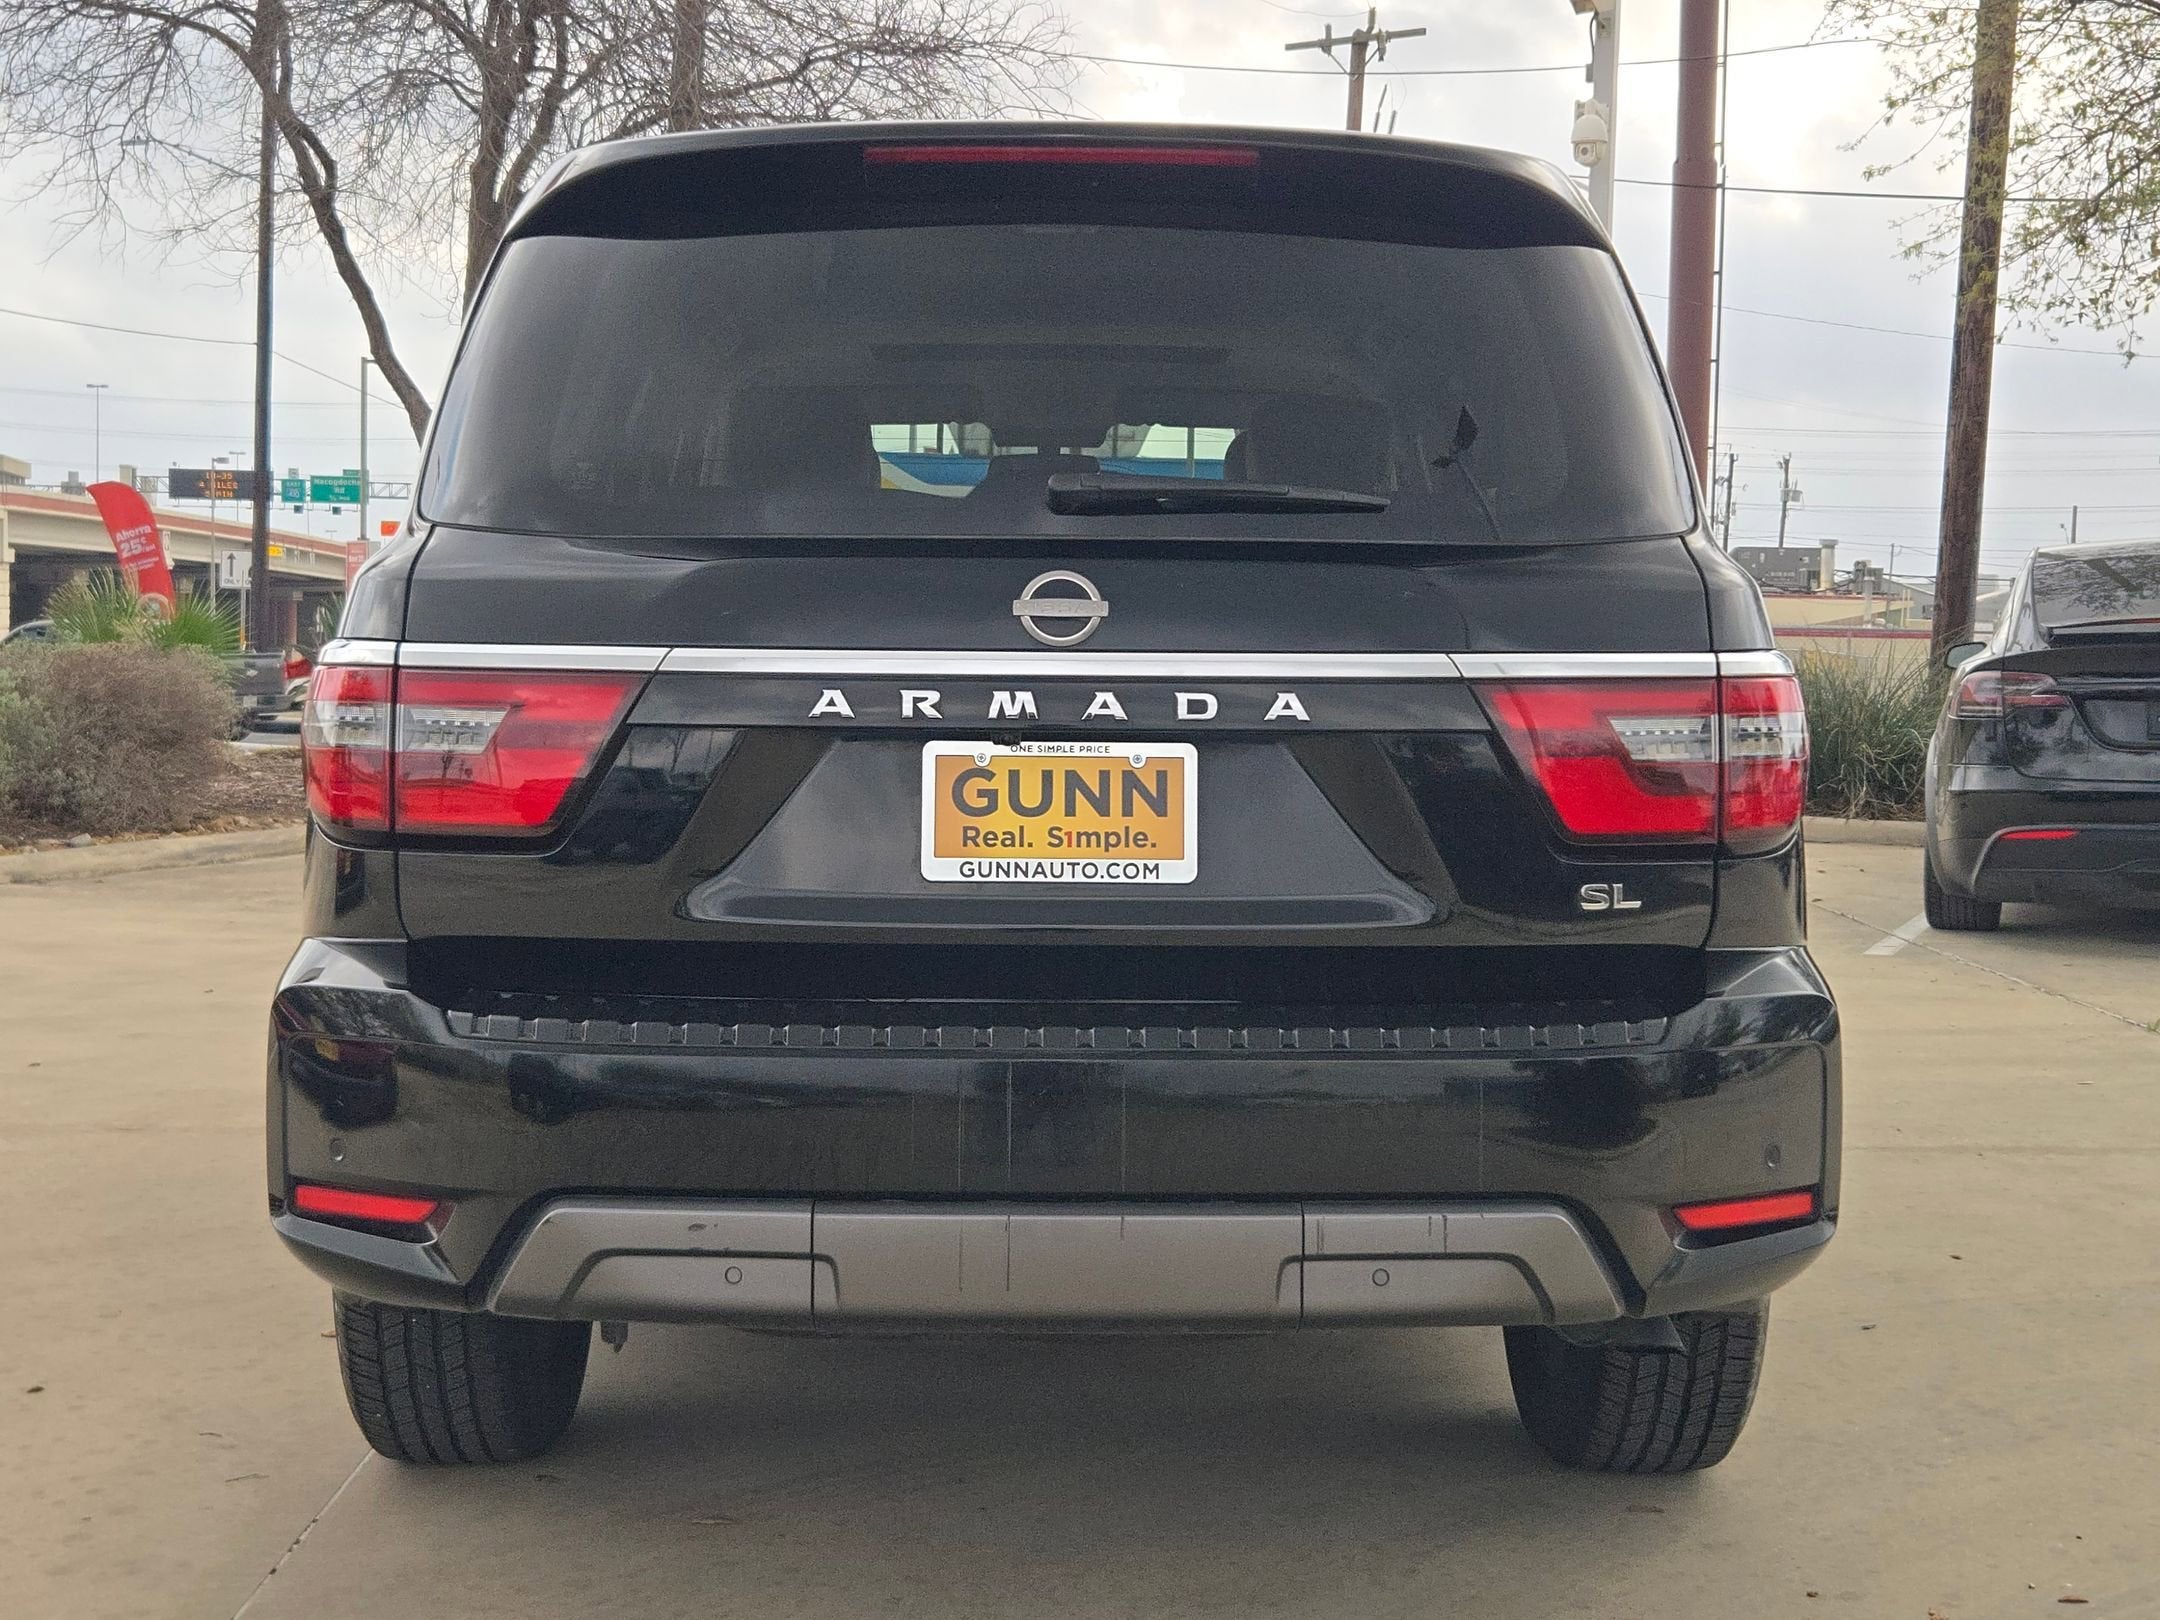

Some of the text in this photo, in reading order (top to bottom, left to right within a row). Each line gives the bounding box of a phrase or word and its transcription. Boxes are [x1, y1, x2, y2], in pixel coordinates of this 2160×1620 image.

[116, 525, 152, 542] Ahorra
[808, 689, 1311, 720] ARMADA
[1010, 744, 1111, 754] ONE SIMPLE PRICE
[951, 767, 1168, 818] GUNN
[962, 825, 1034, 848] Real.
[959, 861, 1160, 880] GUNNAUTO.COM
[1580, 883, 1642, 910] SL
